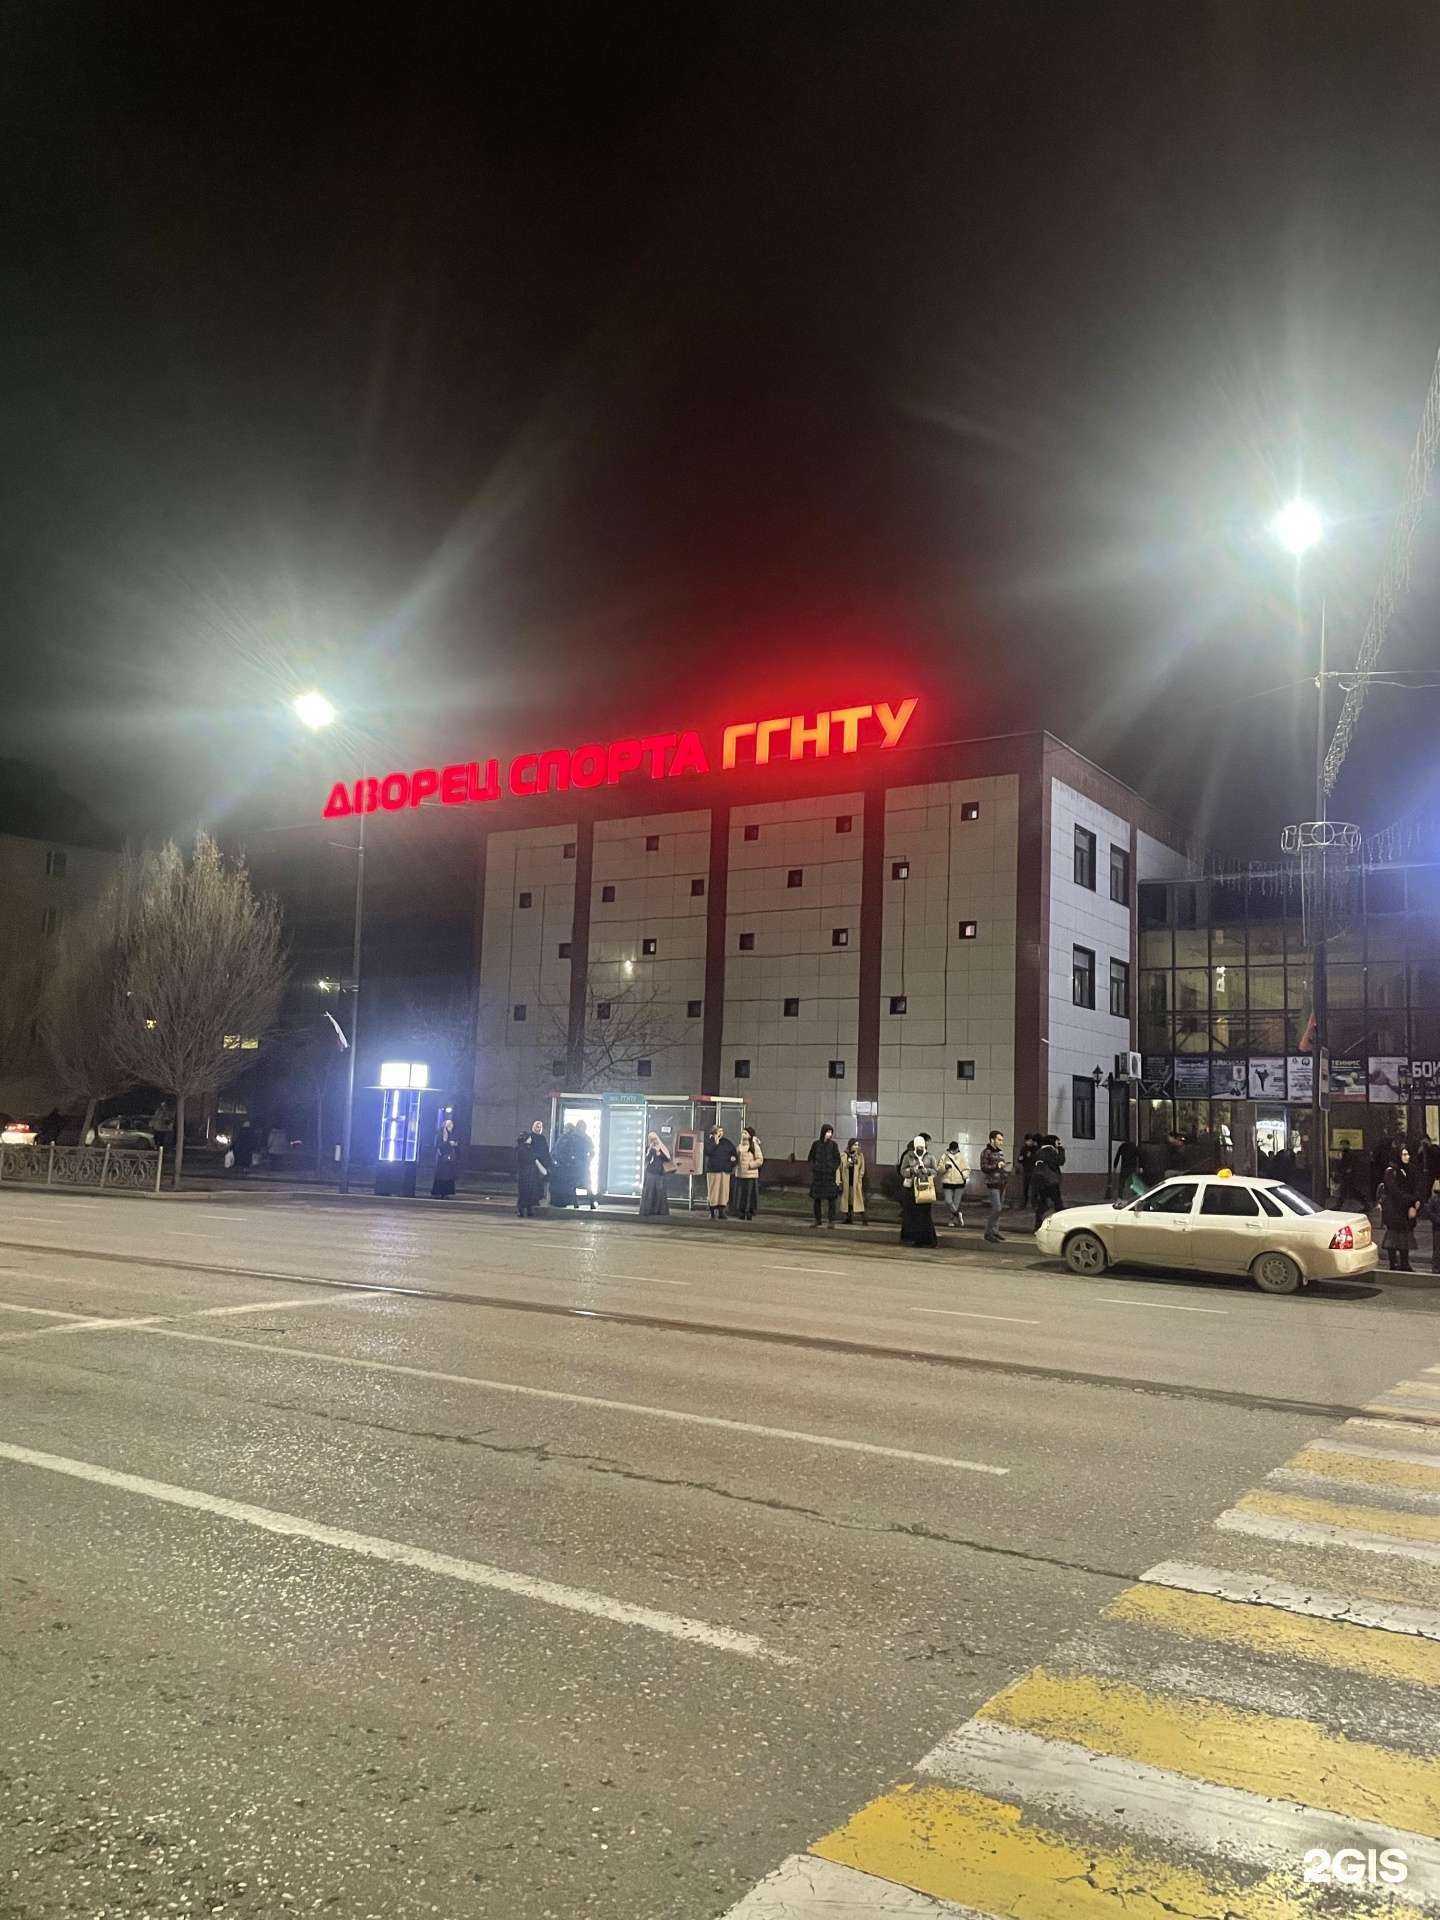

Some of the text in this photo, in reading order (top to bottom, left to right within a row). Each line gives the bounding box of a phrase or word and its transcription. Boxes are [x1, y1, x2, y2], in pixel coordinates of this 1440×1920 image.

[322, 697, 919, 819] ДВОРЕЦ СПОРТА ГГНТУ
